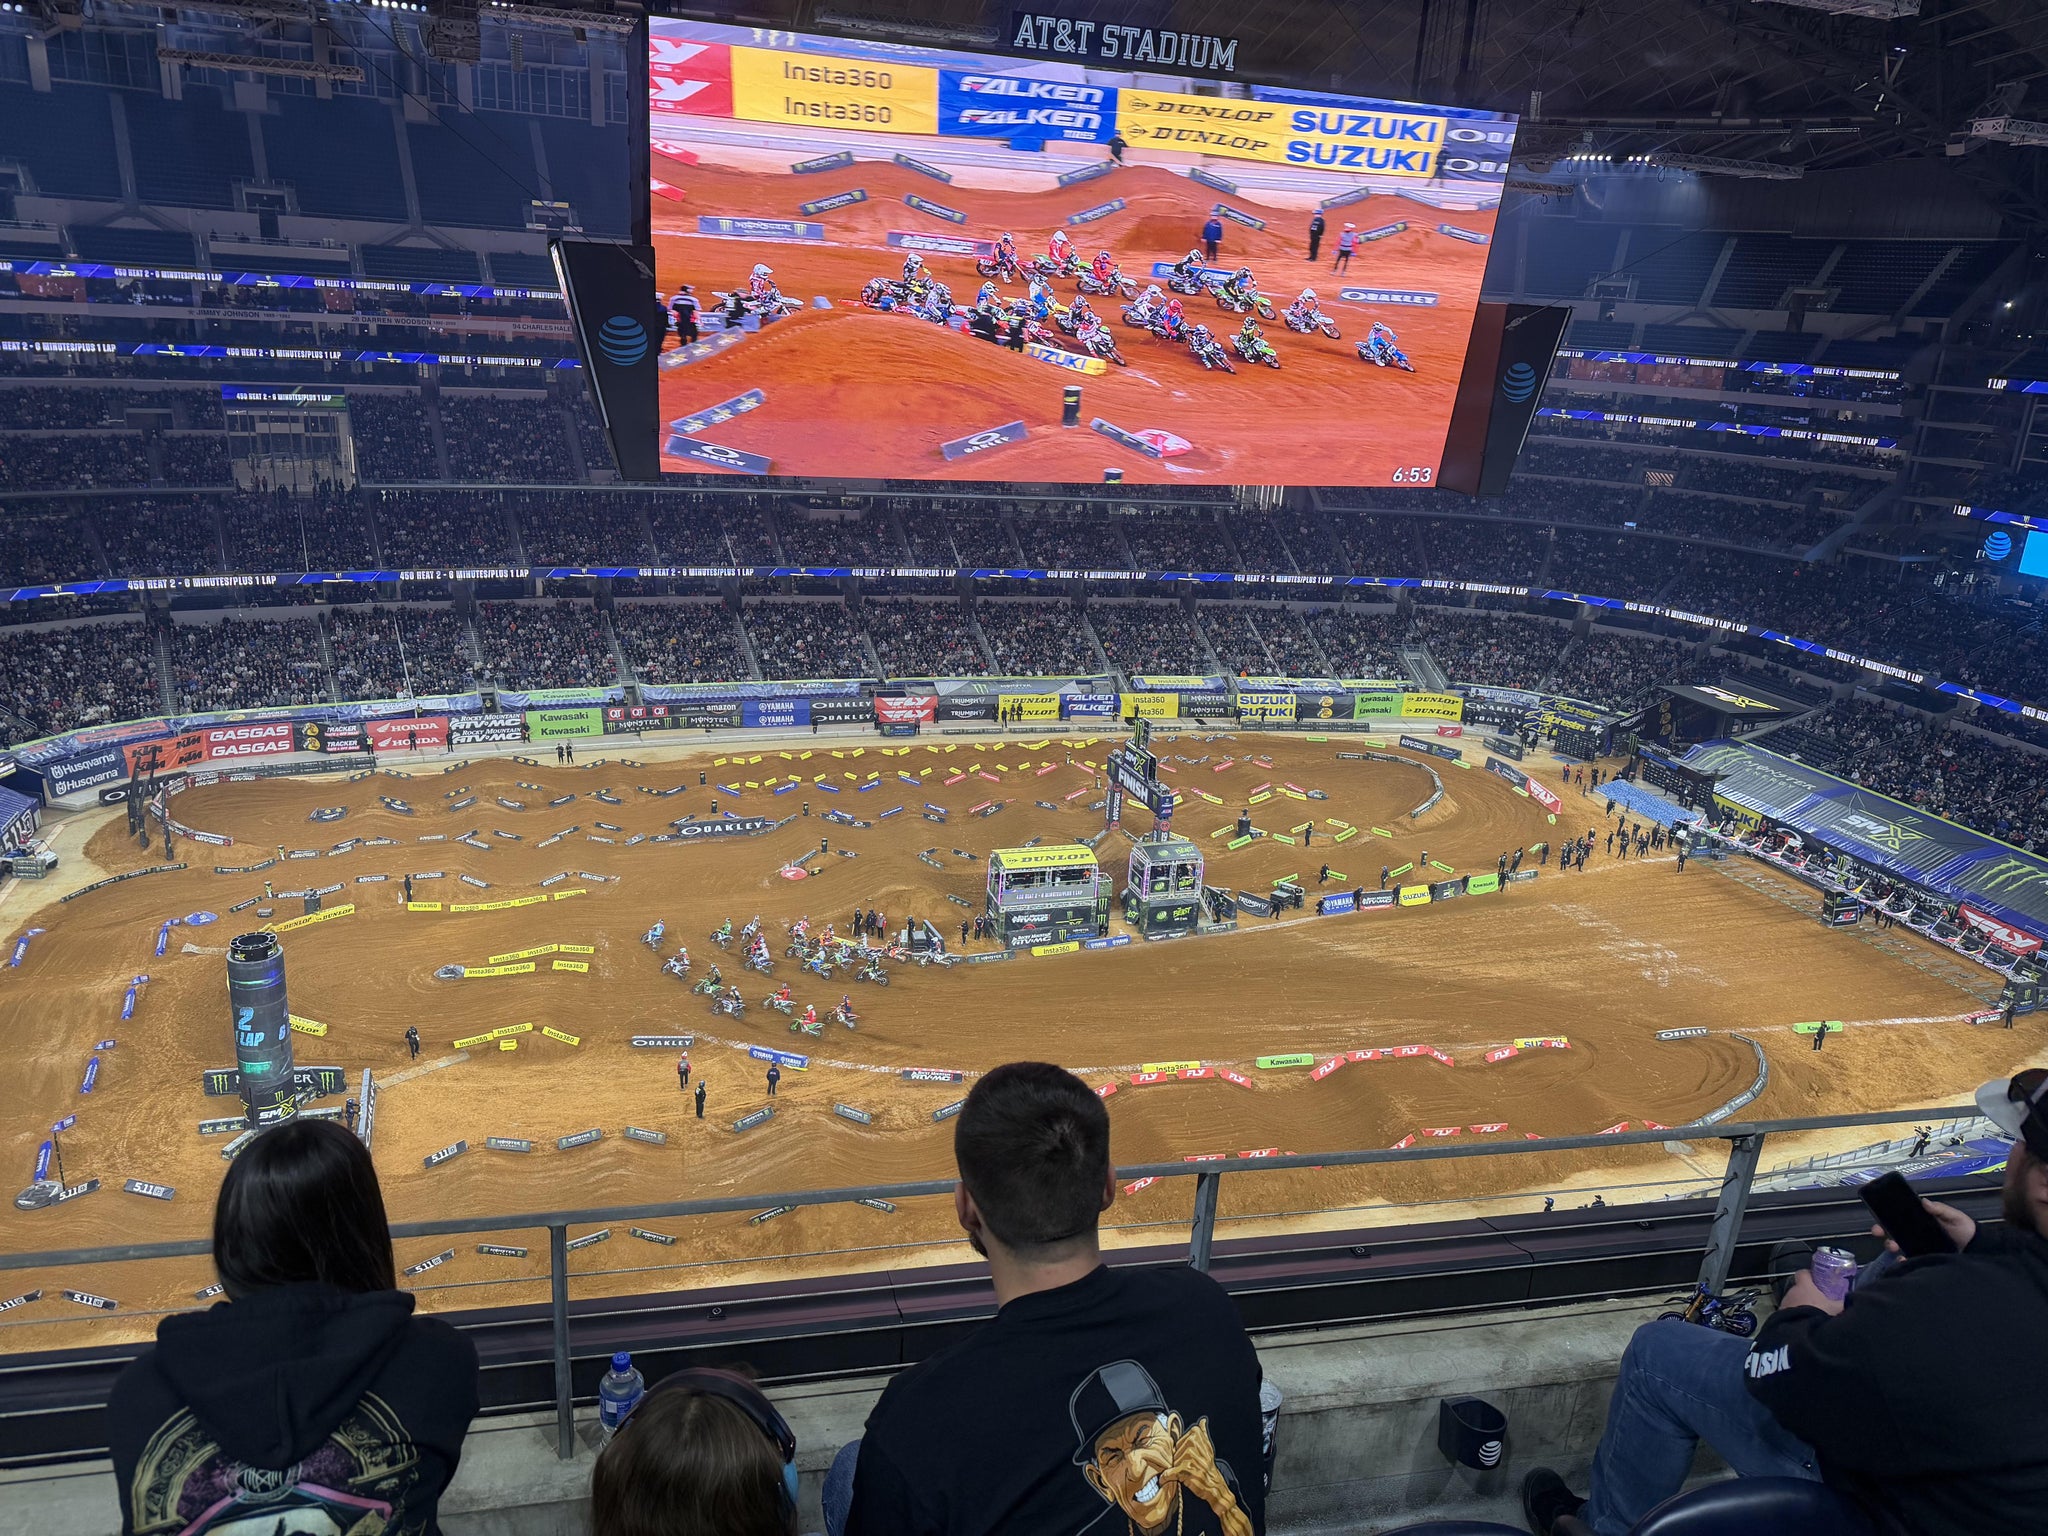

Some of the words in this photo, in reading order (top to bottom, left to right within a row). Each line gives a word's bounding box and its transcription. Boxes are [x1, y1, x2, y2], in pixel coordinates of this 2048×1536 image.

[1014, 14, 1095, 54] AT&T
[1101, 24, 1238, 71] STADIUM
[784, 61, 892, 89] Insta360
[958, 76, 1104, 103] FALKEN
[784, 96, 891, 123] Insta360
[1154, 102, 1274, 122] DUNLOP
[958, 109, 1102, 129] FALKEN
[1291, 111, 1438, 142] SUZUKI
[1151, 127, 1270, 150] DUNLOP
[1286, 141, 1430, 172] SUZUKI
[197, 309, 220, 317] JIMMY
[222, 310, 259, 318] JOHNSON
[361, 316, 392, 324] DARREN
[394, 318, 431, 326] WOODSON
[522, 323, 552, 331] CHARLES
[226, 348, 239, 356] 450
[1994, 379, 2007, 390] LAP
[1392, 467, 1431, 482] 6:53
[400, 571, 414, 580] 450
[416, 571, 434, 580] HEAT
[436, 571, 441, 579] 2
[510, 570, 514, 578] 1
[516, 570, 529, 578] LAP
[128, 580, 144, 590] 450
[147, 579, 167, 589] HEAT
[170, 579, 176, 588] 2
[255, 576, 260, 585] 1
[262, 576, 276, 584] LAP
[1421, 580, 1432, 588] 450
[1434, 581, 1448, 589] HEAT
[881, 697, 931, 706] FLY
[1240, 695, 1294, 705] SUZUKI
[1415, 696, 1459, 705] DUNLOP
[706, 703, 736, 711] amazon
[766, 702, 794, 710] YAMAHA
[609, 709, 622, 719] QT
[632, 708, 643, 717] QT
[654, 707, 665, 716] QT
[881, 710, 931, 718] FLY
[1413, 707, 1457, 716] DUNLOP
[2021, 706, 2035, 718] 450
[540, 712, 589, 722] Kawasaki
[766, 715, 794, 723] YAMAHA
[390, 723, 439, 732] HONDA
[619, 718, 660, 729] MONSTER
[210, 726, 289, 741] GASGAS
[327, 725, 357, 733] TRACKER
[541, 726, 590, 736] Kawasaki
[176, 735, 201, 749] KTM
[327, 739, 358, 748] TRACKER
[212, 741, 290, 756] GASGAS
[178, 751, 202, 764] KTM
[62, 753, 116, 775] Husqvarna
[1124, 751, 1146, 776] SMX
[67, 769, 118, 790] Husqvarna
[1118, 768, 1148, 804] FINISH
[704, 821, 762, 833] OAKLEY
[1021, 853, 1090, 863] DUNLOP
[1403, 891, 1429, 901] SUZUKI
[1331, 897, 1354, 907] YAMAHA
[322, 907, 353, 919] DUNLOP
[284, 917, 312, 929] DUNLOP
[527, 946, 553, 955] Insta360
[1043, 945, 1070, 954] Insta360
[493, 953, 520, 962] Insta360
[468, 968, 496, 976] Insta360
[237, 1007, 254, 1031] 2
[497, 1025, 526, 1034] Insta360
[1674, 1028, 1707, 1037] OAKLEY
[239, 1032, 264, 1046] LAP
[459, 1036, 488, 1046] Insta360
[547, 1030, 575, 1043] Insta360
[1355, 1051, 1372, 1059] FLY
[1433, 1051, 1447, 1060] FLY
[1494, 1049, 1510, 1060] FLY
[1270, 1056, 1303, 1066] Kawasaki
[1319, 1060, 1335, 1075] FLY
[1186, 1069, 1206, 1077] FLY
[1228, 1073, 1246, 1082] FLY
[258, 1097, 295, 1119] SMX
[431, 1149, 449, 1163] 5.11
[1249, 1150, 1270, 1158] FLY
[134, 1182, 153, 1194] 5.11
[1134, 1177, 1154, 1191] FLY
[59, 1187, 78, 1200] 5.11
[415, 1261, 434, 1273] 5.11
[73, 1293, 93, 1305] 5.11
